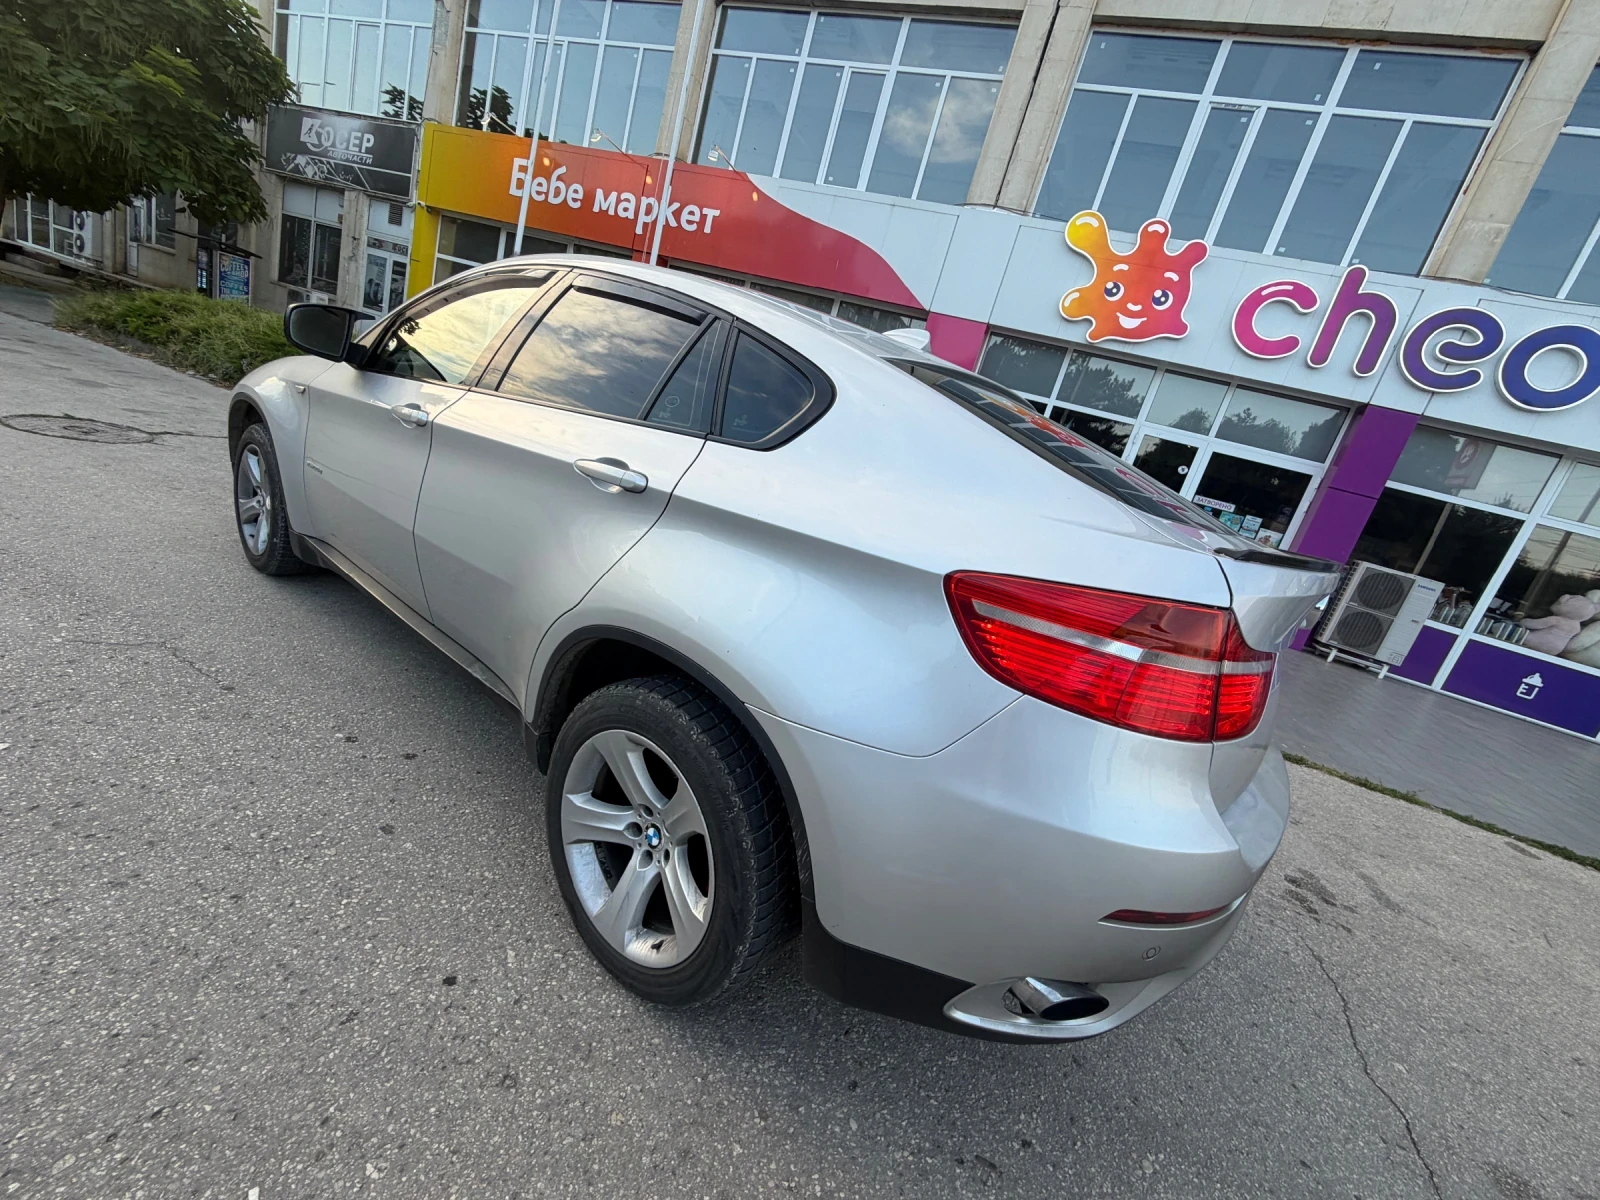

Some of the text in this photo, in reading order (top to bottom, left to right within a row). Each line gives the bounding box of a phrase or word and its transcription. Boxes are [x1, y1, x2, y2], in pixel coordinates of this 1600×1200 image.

[327, 150, 373, 165] АВТОЧАСТИ
[508, 157, 721, 235] Бебе маркет
[1231, 264, 1600, 412] cheo
[1195, 496, 1233, 511] ЗАТВОРЕНО
